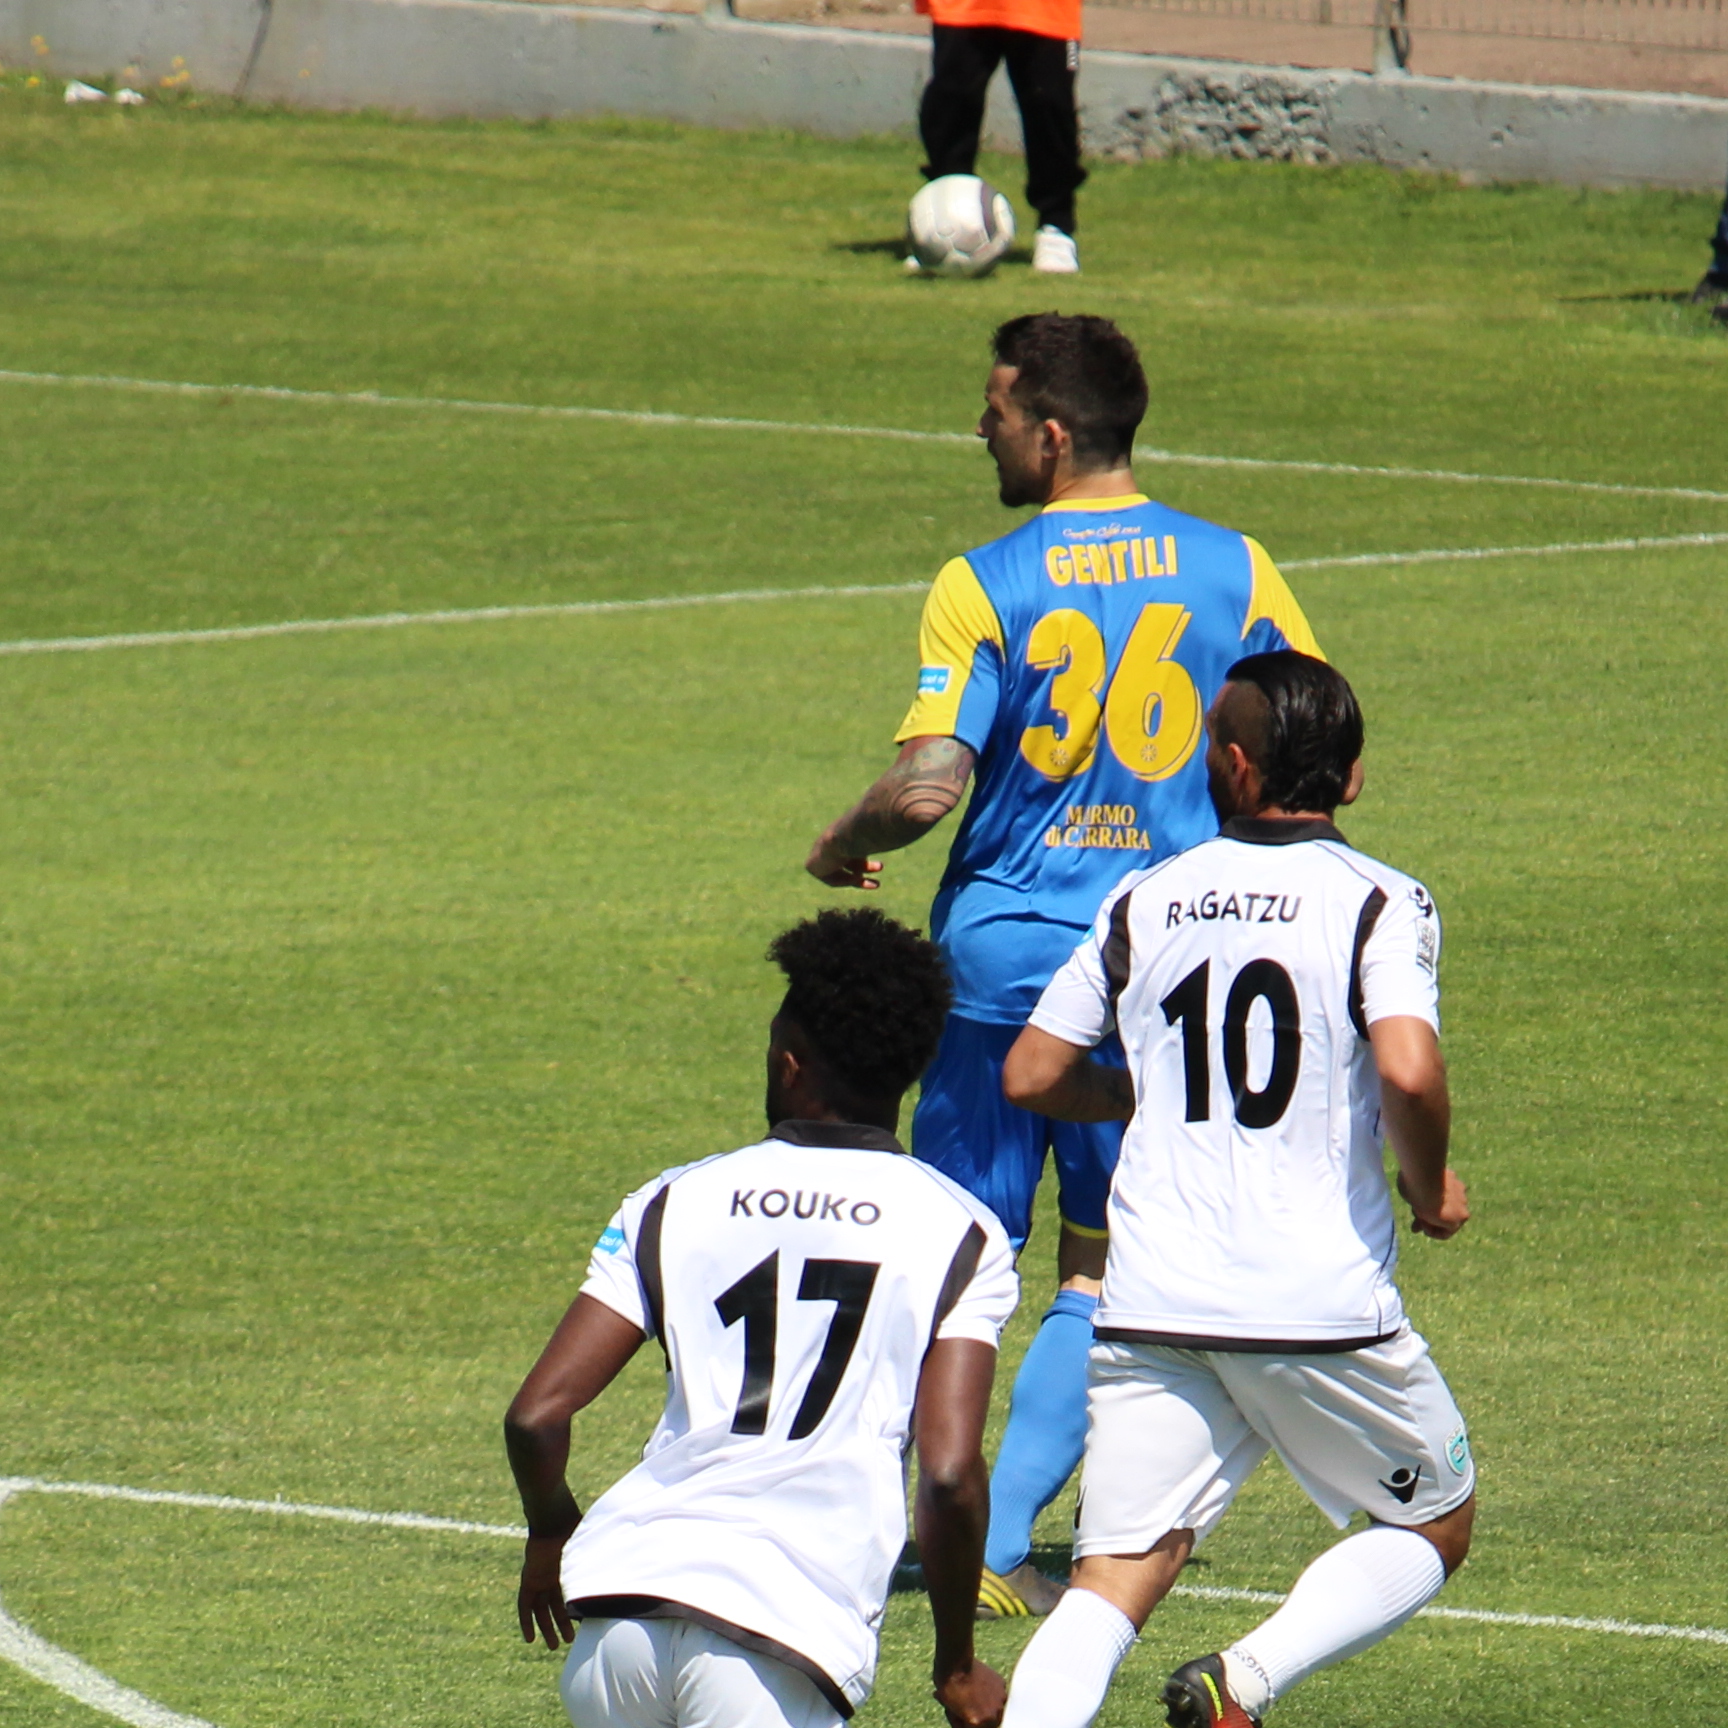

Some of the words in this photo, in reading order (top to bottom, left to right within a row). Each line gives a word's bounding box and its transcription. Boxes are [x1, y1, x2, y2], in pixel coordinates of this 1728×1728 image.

[1045, 534, 1178, 588] GENTILI
[1019, 602, 1202, 783] 36
[1043, 824, 1062, 848] di
[1065, 803, 1137, 827] MARMO
[1165, 889, 1303, 929] RAGATZU
[1159, 956, 1302, 1129] 10
[728, 1189, 882, 1226] KOUKO
[713, 1247, 882, 1441] 17
